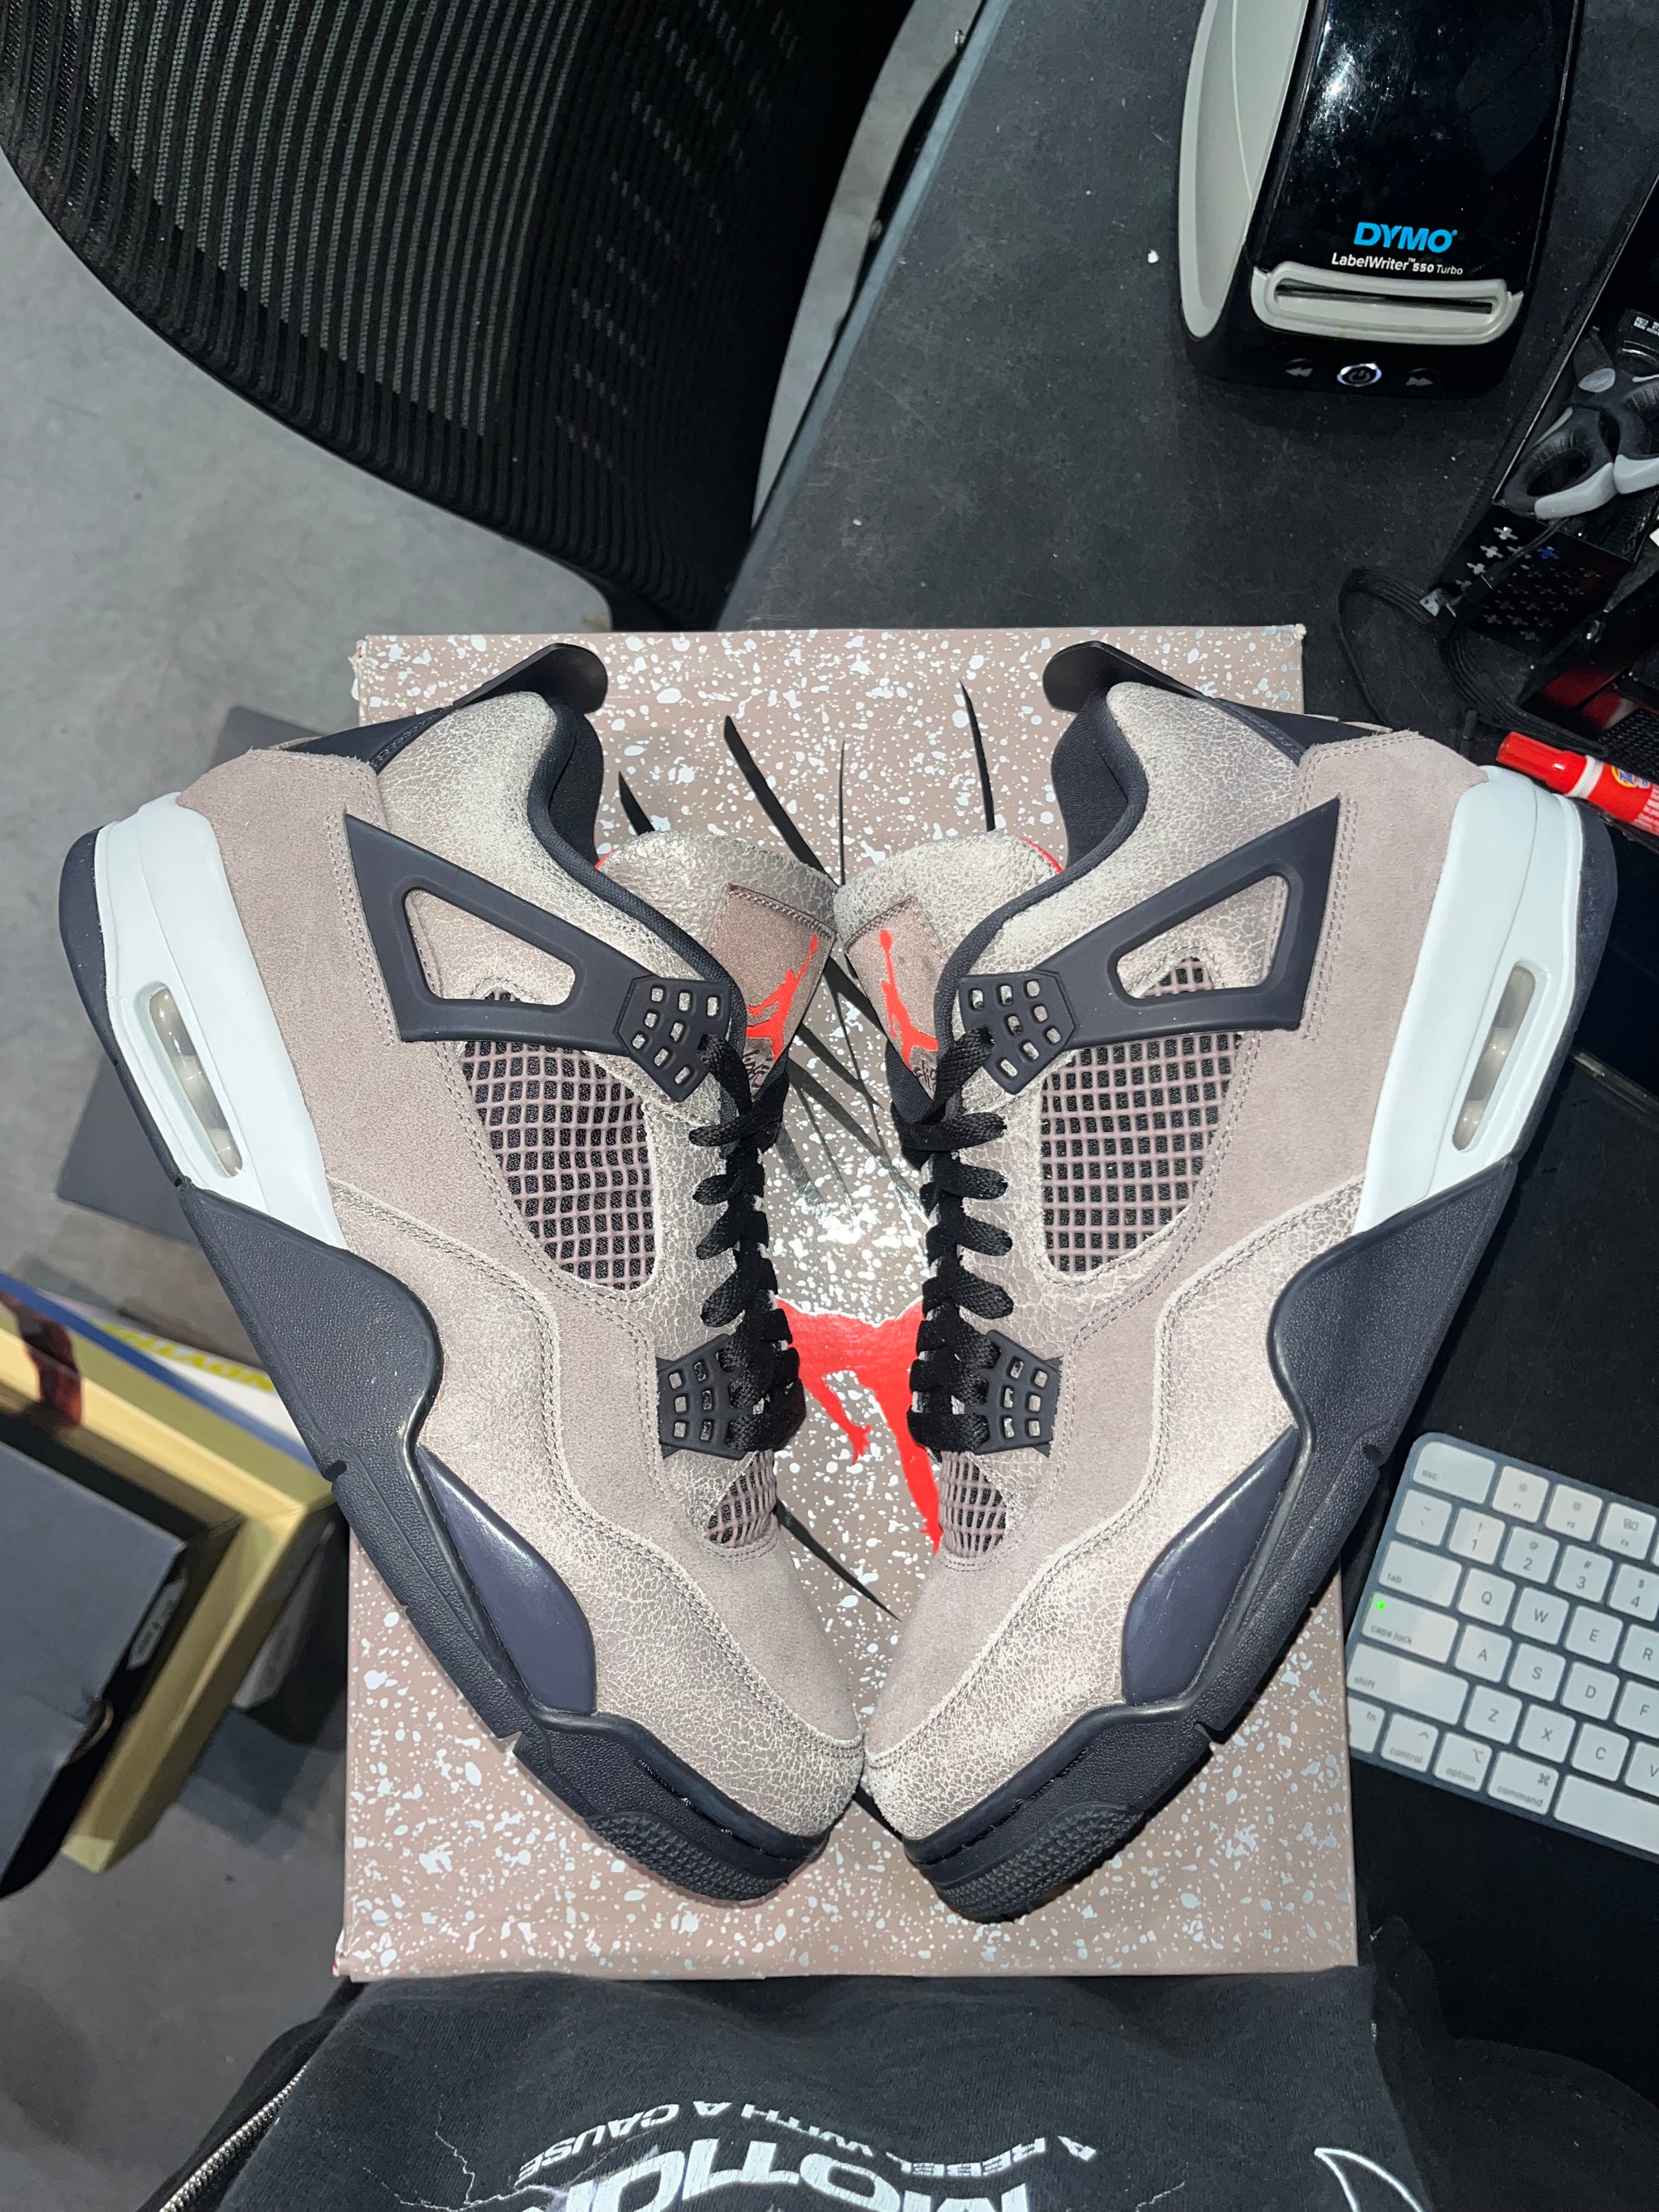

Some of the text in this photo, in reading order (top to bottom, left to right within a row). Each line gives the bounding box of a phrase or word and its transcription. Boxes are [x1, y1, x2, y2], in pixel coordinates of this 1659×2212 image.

[1354, 221, 1452, 254] DYMO
[1412, 263, 1435, 273] 550
[1437, 264, 1464, 275] Turbo
[1422, 1470, 1438, 1481] esc
[1472, 1539, 1478, 1552] 1
[1523, 1557, 1534, 1572] 2
[1387, 1573, 1403, 1584] tab
[1576, 1576, 1587, 1590] 3
[1481, 1591, 1493, 1606] Q
[1630, 1596, 1641, 1608] 4
[1535, 1608, 1550, 1624] W
[1370, 1624, 1413, 1646] caps lock
[1588, 1628, 1600, 1643] E
[1477, 1648, 1488, 1662] A
[1642, 1647, 1654, 1661] R
[1531, 1665, 1543, 1680] S
[1353, 1675, 1375, 1689] shift
[1584, 1685, 1597, 1699] D
[1365, 1711, 1377, 1723] fn
[1487, 1708, 1500, 1723] Z
[1639, 1704, 1651, 1716] F
[1540, 1727, 1554, 1742] X
[1389, 1746, 1424, 1764] control
[1594, 1746, 1607, 1760] C
[1446, 1767, 1477, 1783] option
[1496, 1785, 1545, 1807] command
[513, 2100, 1097, 2189] A REBEL WITH A CAUSE
